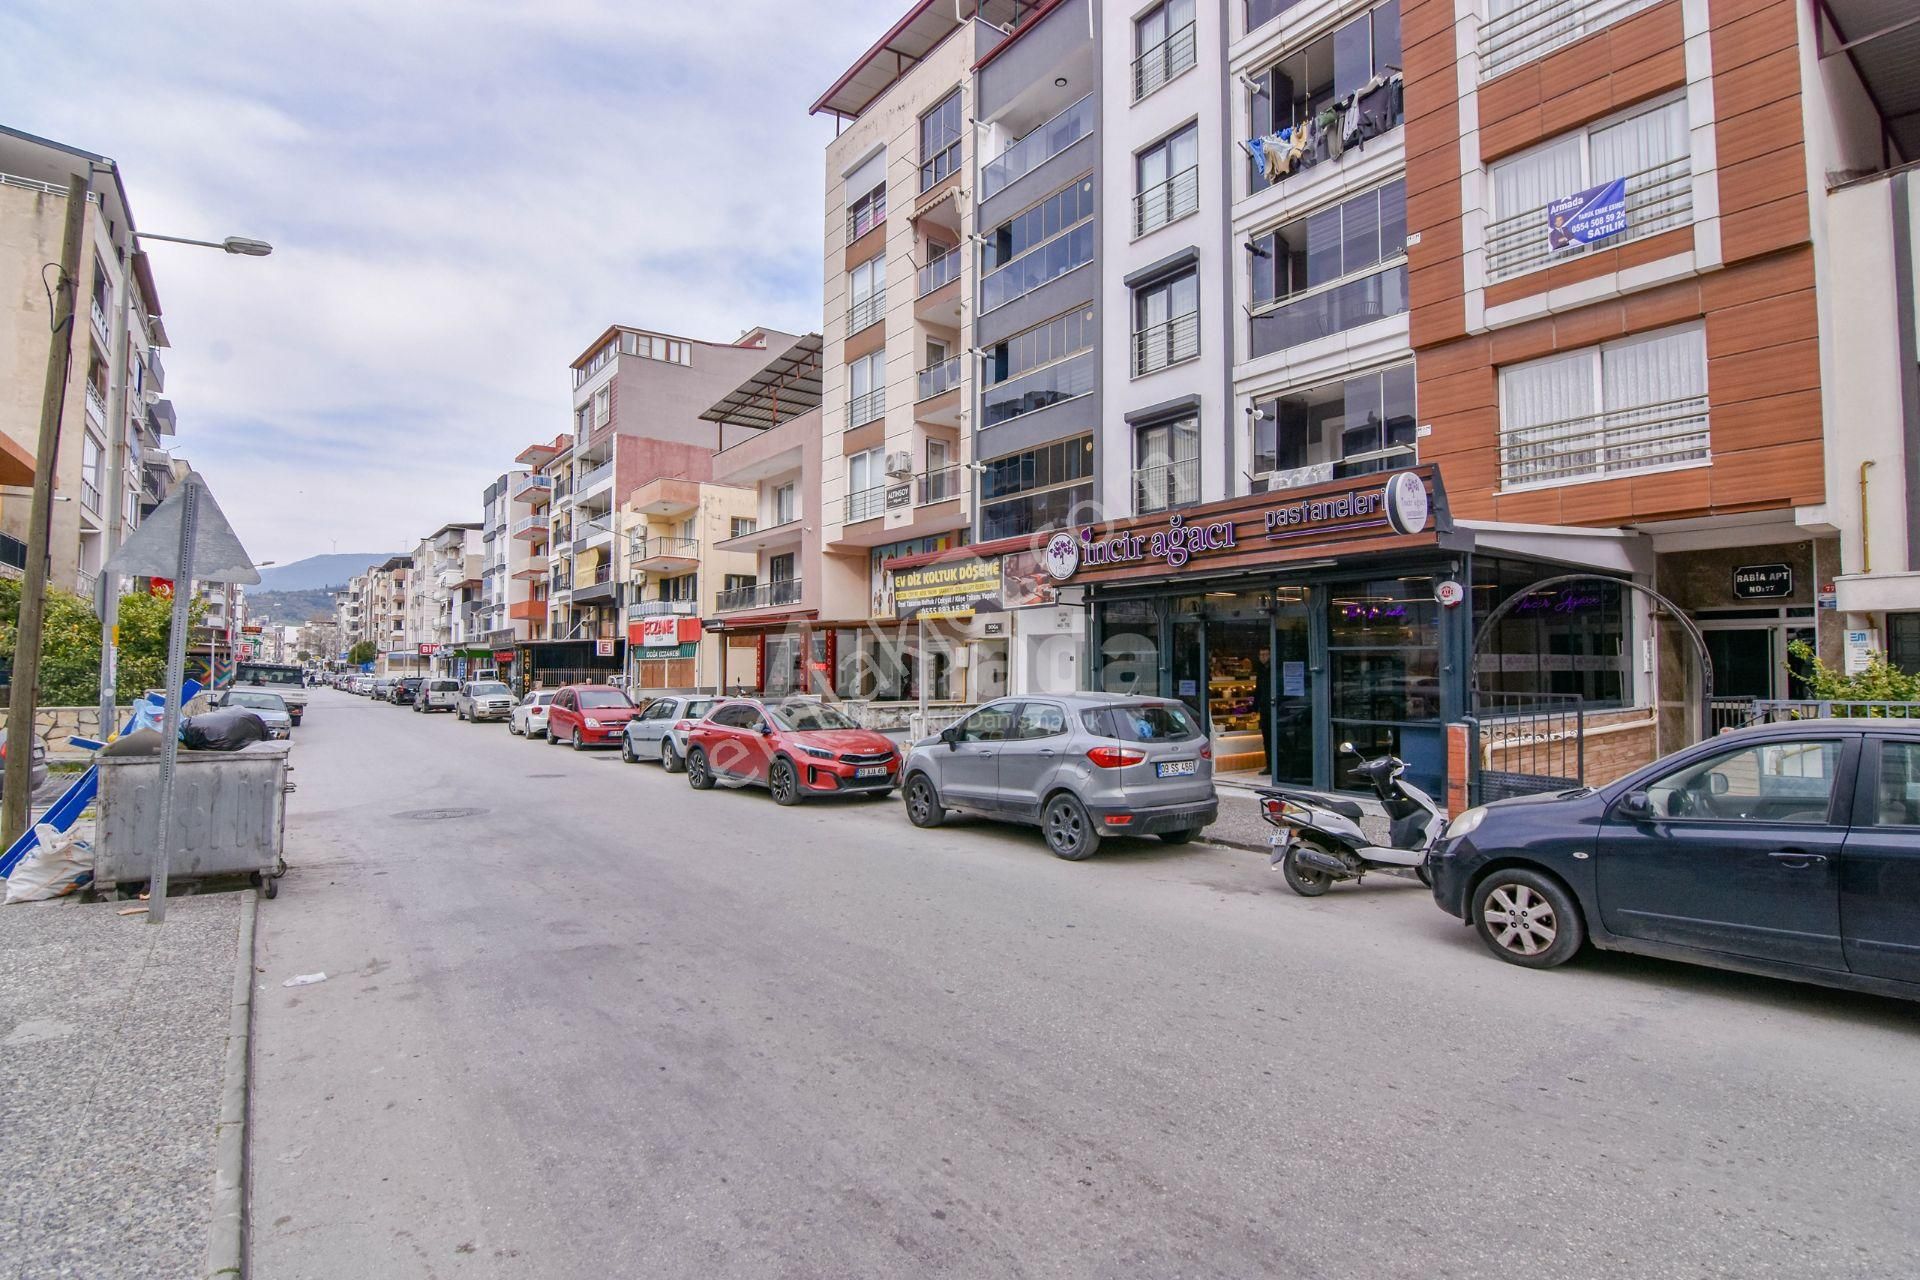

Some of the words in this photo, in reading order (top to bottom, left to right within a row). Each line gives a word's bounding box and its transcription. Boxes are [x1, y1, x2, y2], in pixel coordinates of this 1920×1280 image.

[1550, 196, 1584, 215] Armada
[1571, 221, 1589, 233] 0554
[1605, 213, 1615, 223] 59
[1587, 219, 1626, 239] SATILIK
[1264, 488, 1387, 533] pastaneleri
[1080, 526, 1146, 567] incir
[1150, 514, 1236, 568] ağacı
[895, 575, 907, 588] EV
[907, 571, 922, 586] DİZ
[923, 566, 958, 585] KOLTUK
[959, 561, 1000, 581] DÖŞEME
[1736, 571, 1766, 583] RABİA
[1769, 571, 1789, 582] APT
[644, 618, 675, 635] ECZANE
[422, 643, 440, 654] BİM
[601, 643, 610, 653] E
[1170, 762, 1180, 773] SS
